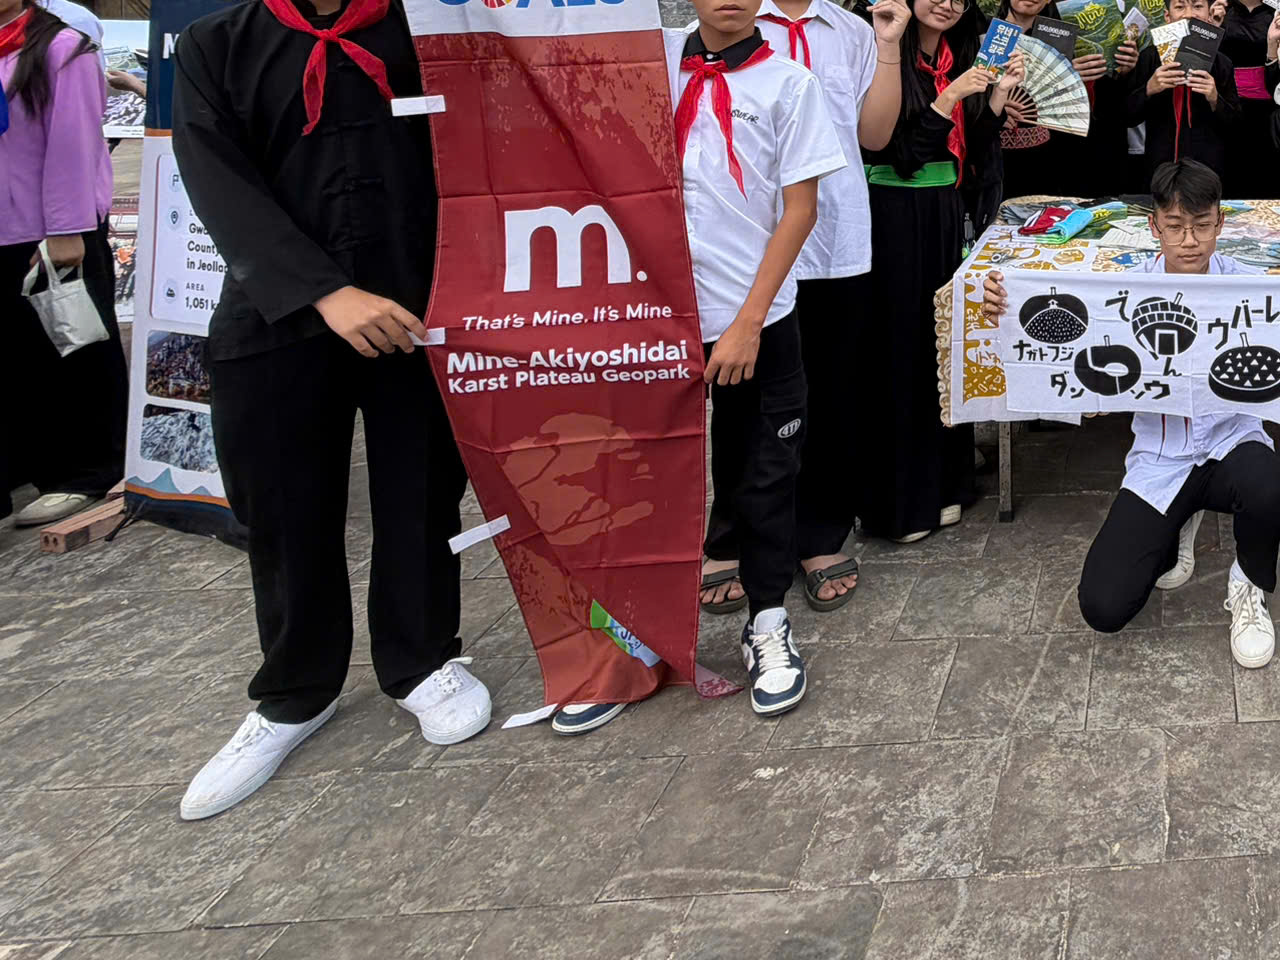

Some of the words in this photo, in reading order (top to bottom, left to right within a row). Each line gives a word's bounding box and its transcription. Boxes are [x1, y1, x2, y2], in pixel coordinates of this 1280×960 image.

[186, 257, 196, 270] in
[185, 282, 205, 292] AREA
[185, 296, 209, 310] 1,051
[462, 313, 525, 331] That's
[532, 309, 589, 327] Mine.
[593, 305, 620, 323] It's
[625, 302, 673, 321] Mine
[447, 339, 689, 375] Mine-Akiyoshidai
[448, 372, 509, 394] Karst
[515, 368, 597, 388] Plateau
[601, 363, 691, 385] Geopark
